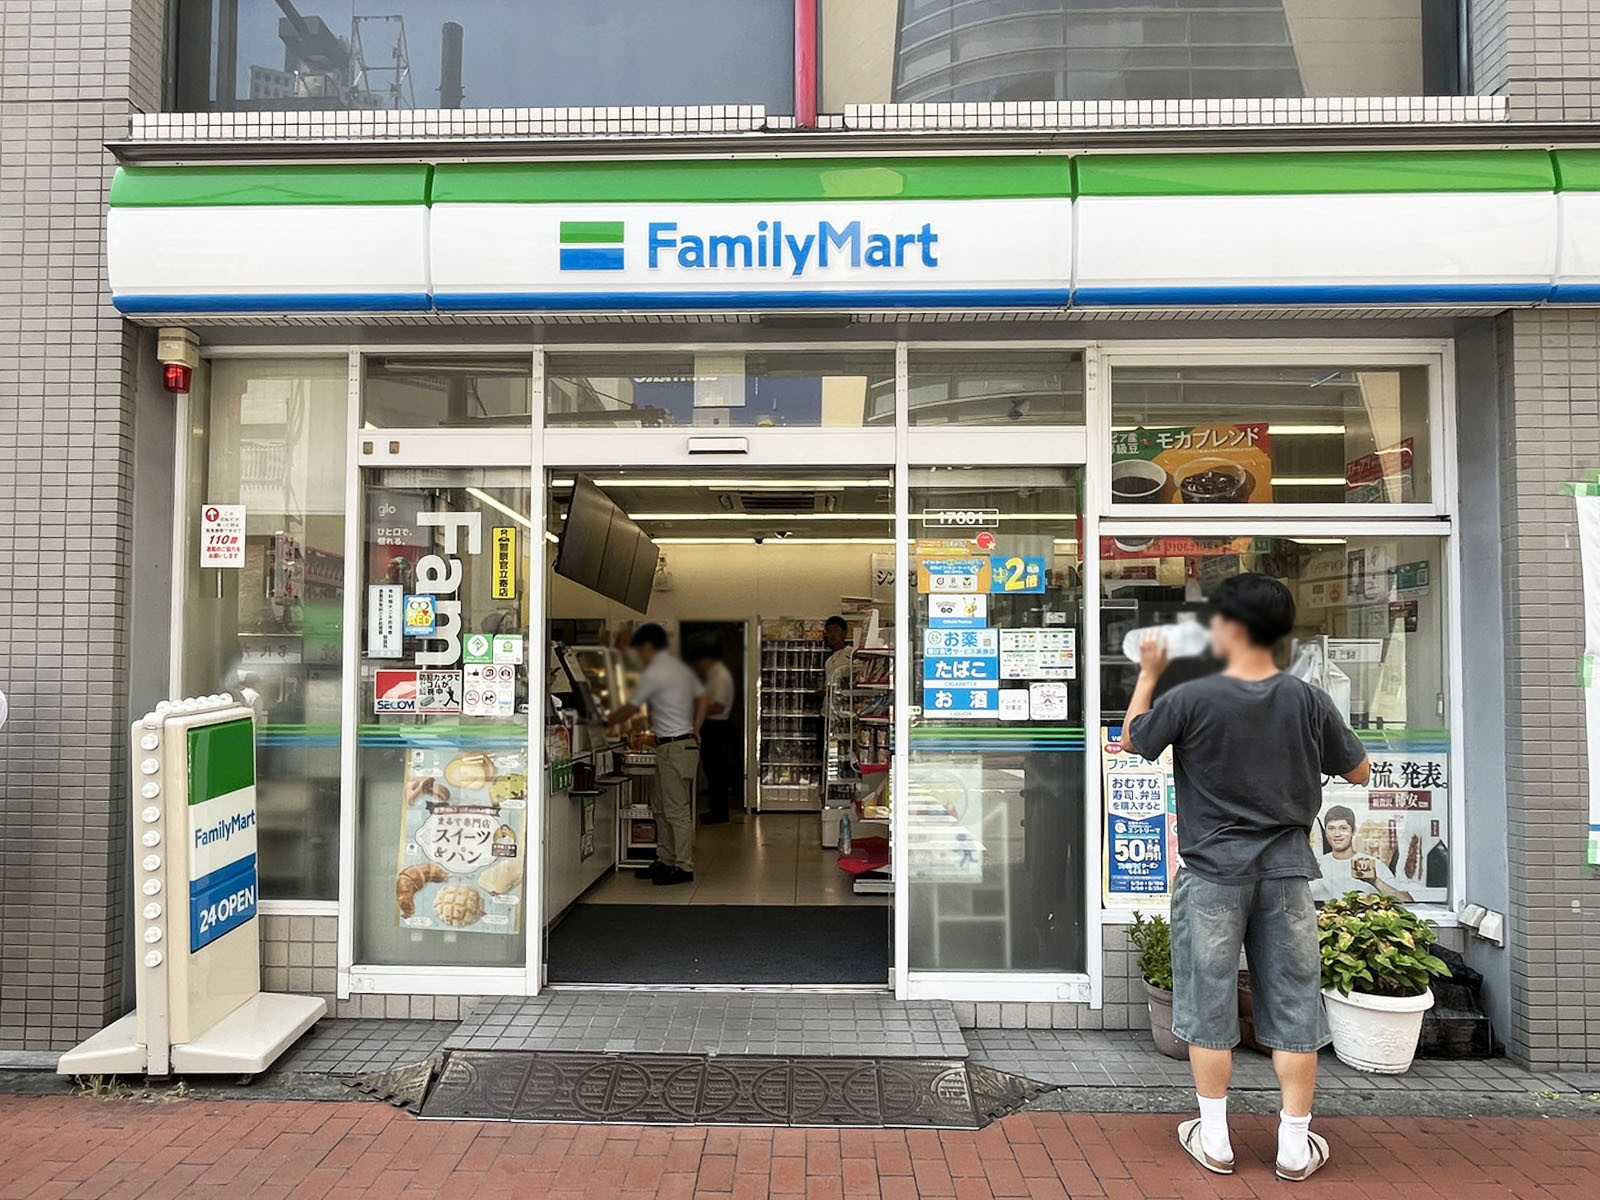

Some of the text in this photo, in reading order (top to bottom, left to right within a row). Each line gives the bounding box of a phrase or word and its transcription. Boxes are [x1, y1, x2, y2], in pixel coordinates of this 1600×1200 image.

[648, 220, 940, 276] FamilyMart
[1157, 428, 1260, 449] モカブレンド
[378, 503, 397, 517] glo
[944, 631, 977, 647] お薬
[935, 660, 987, 678] たばこ
[377, 700, 415, 709] SECOM
[1112, 778, 1161, 789] おむすび、
[1112, 789, 1161, 801] 寿司、弁当
[1112, 801, 1161, 811] を購入すると
[194, 809, 256, 849] FamilyMart
[432, 828, 491, 846] スイーツ
